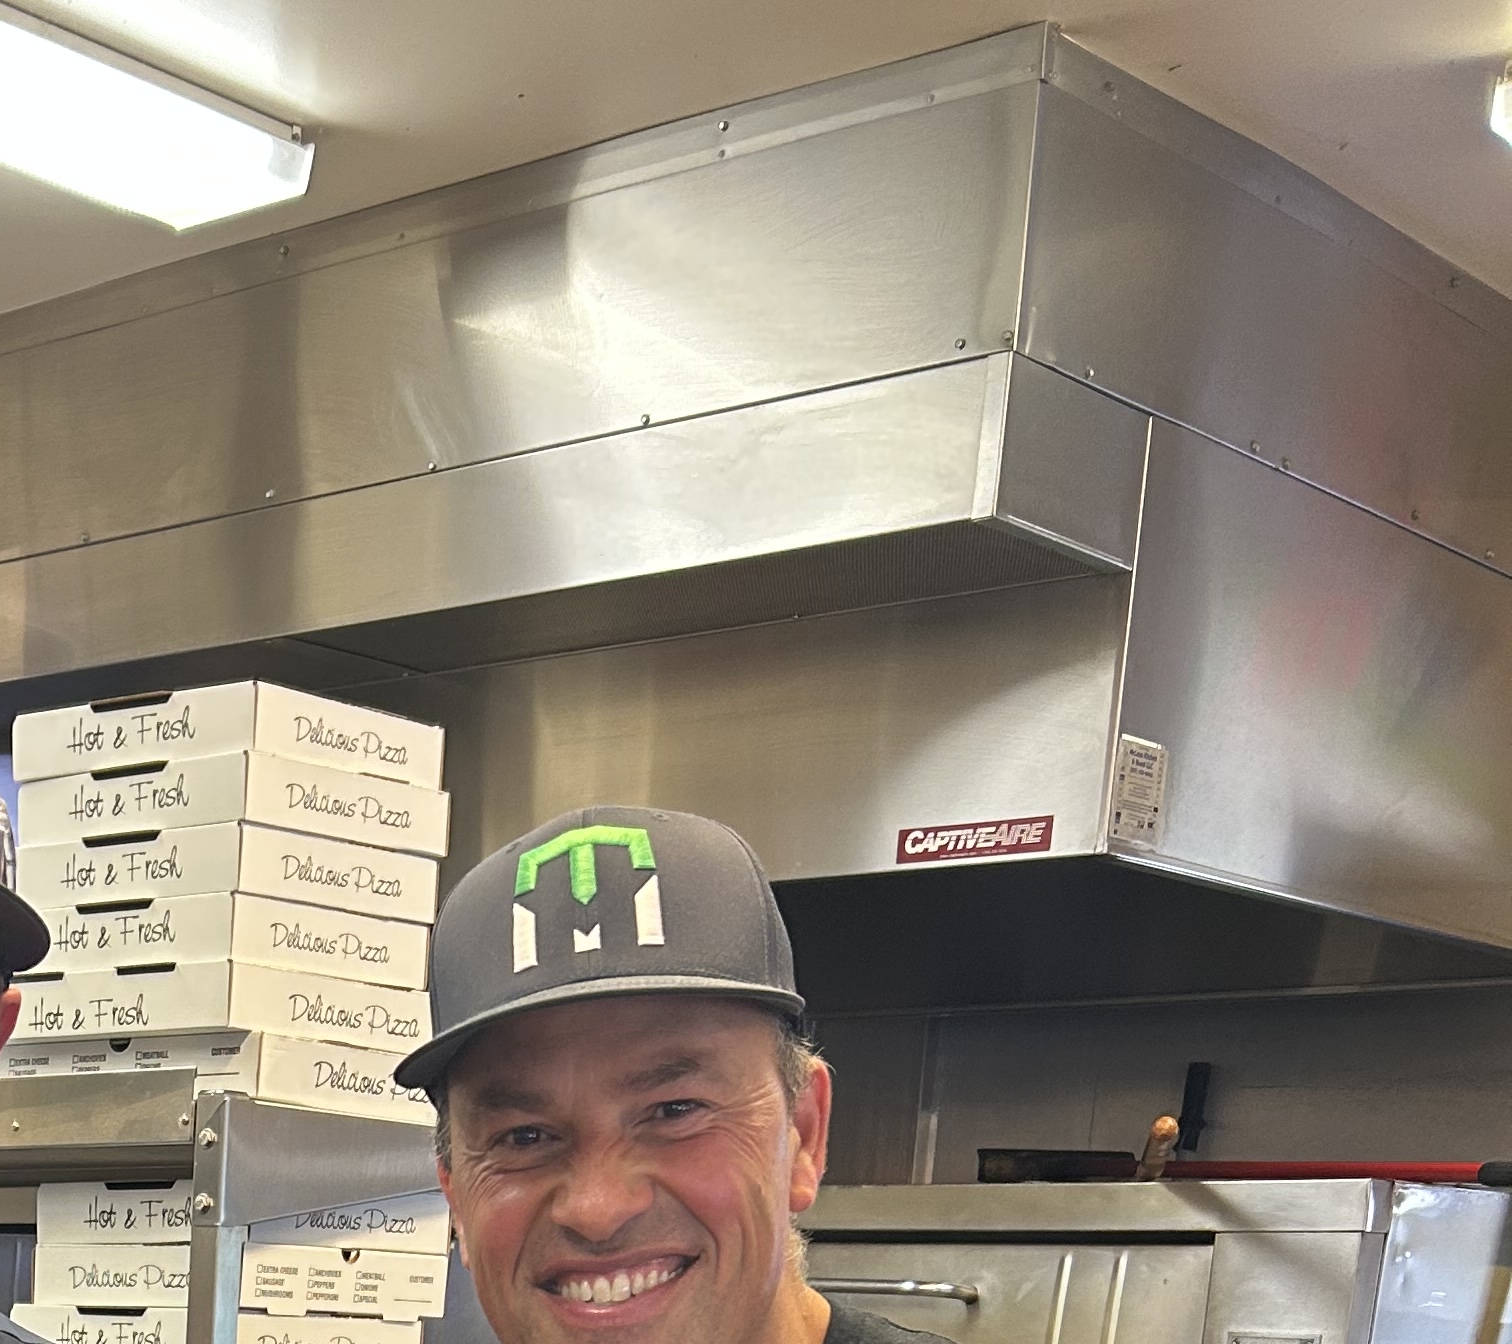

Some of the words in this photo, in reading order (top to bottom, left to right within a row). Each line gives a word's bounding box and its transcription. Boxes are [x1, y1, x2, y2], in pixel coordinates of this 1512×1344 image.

[67, 717, 104, 751] Hot
[113, 727, 129, 749] &
[131, 705, 197, 743] Fresh
[293, 715, 359, 754] Delicious
[361, 727, 409, 767] Pizza
[68, 784, 104, 819] Hot
[112, 793, 128, 816] &
[129, 773, 191, 811] Fresh
[285, 782, 357, 822] Delicious
[359, 794, 412, 829] Pizza
[904, 820, 1047, 856] CAPTIVEAIRE
[60, 853, 96, 889] Hot
[104, 863, 119, 886] &
[121, 845, 183, 882] Fresh
[281, 854, 351, 892] Delicious
[352, 864, 403, 899] Pizza
[53, 916, 90, 951] Hot
[97, 923, 111, 946] &
[113, 909, 177, 945] Fresh
[270, 921, 338, 957] Delicious
[339, 933, 391, 965] Pizza
[28, 996, 65, 1033] Hot
[72, 1006, 87, 1031] &
[88, 992, 150, 1029] Fresh
[288, 993, 362, 1031] Delicious
[363, 1003, 421, 1039] Pizza
[313, 1059, 386, 1098] Delicious
[83, 1195, 117, 1232] Hot
[123, 1213, 138, 1230] &
[139, 1196, 192, 1229] Fresh
[363, 1207, 416, 1235] Pizza
[68, 1263, 138, 1290] Delicious
[137, 1263, 190, 1290] Pizz
